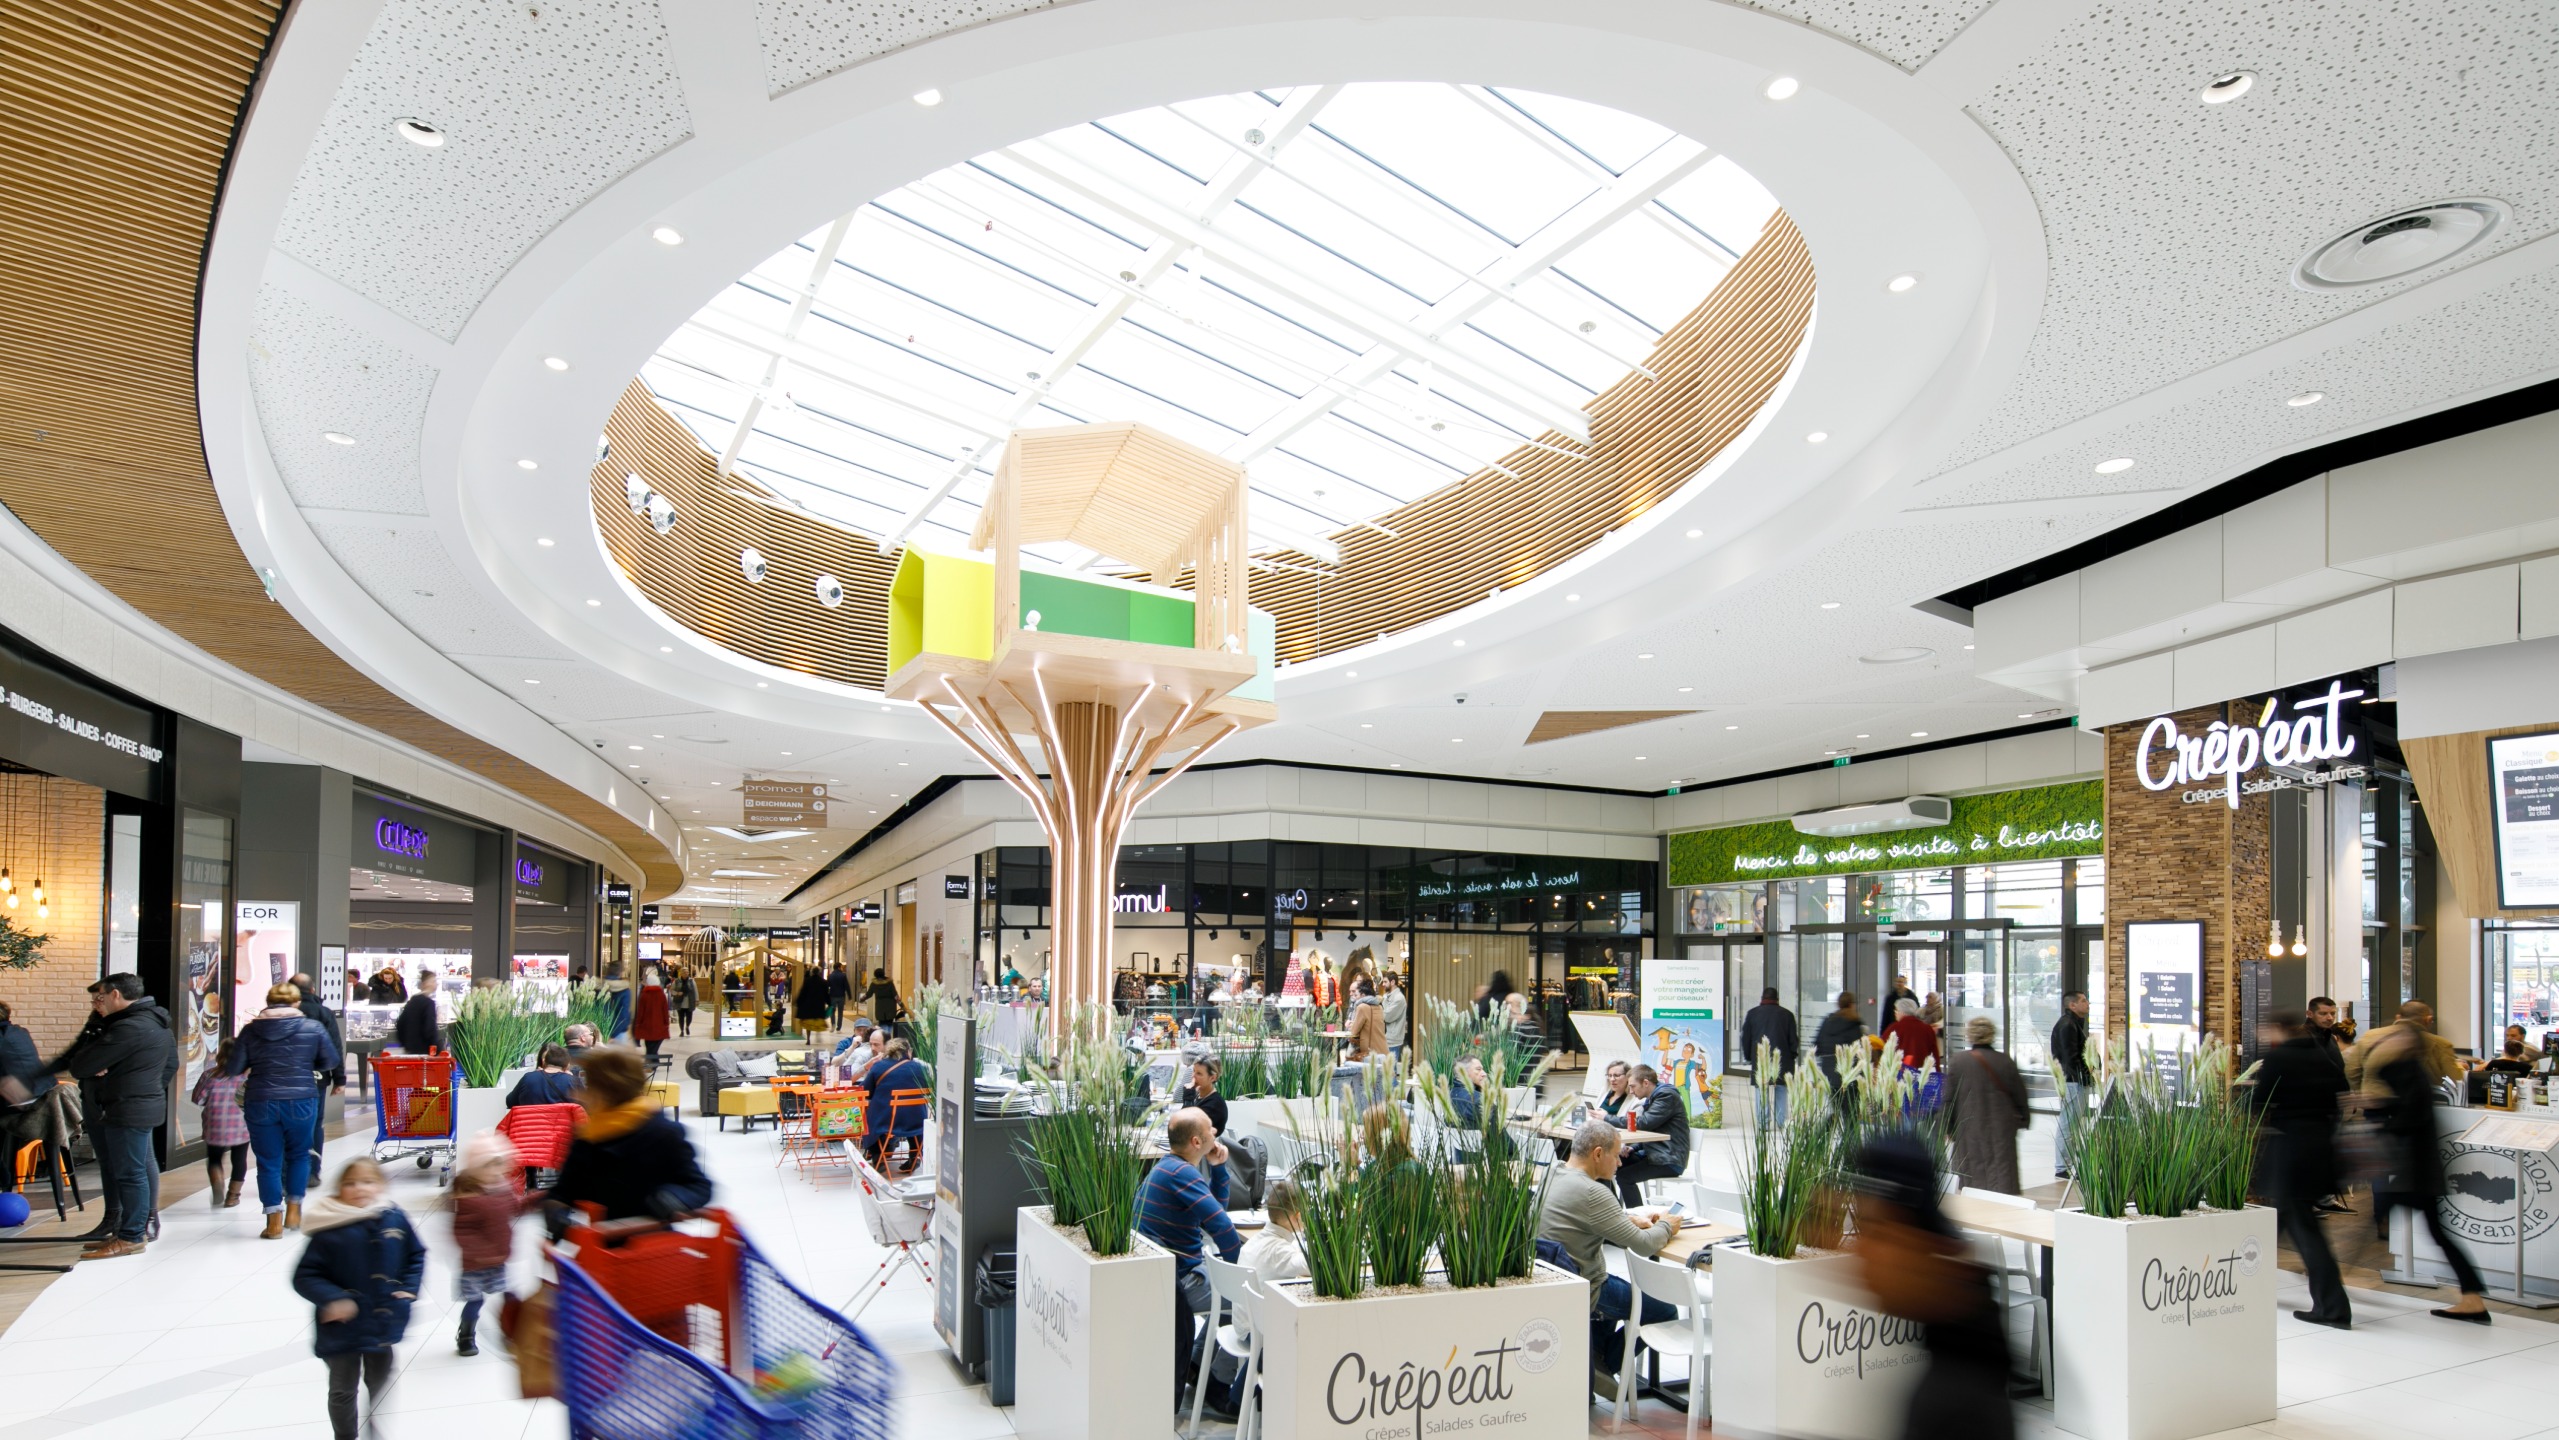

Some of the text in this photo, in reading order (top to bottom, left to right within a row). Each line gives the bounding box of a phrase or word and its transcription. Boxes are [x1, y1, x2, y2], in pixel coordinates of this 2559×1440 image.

[10, 691, 53, 724] BURGERS
[59, 713, 100, 742] SALADES
[105, 732, 138, 756] COFFEE
[139, 744, 163, 763] SHOP
[2136, 680, 2364, 809] Crêp'eat
[2505, 759, 2543, 768] Classique
[745, 785, 803, 793] promod
[2182, 788, 2228, 805] Crêpes
[2303, 766, 2366, 786] Gaufres
[1734, 855, 1788, 871] Merci
[1792, 844, 1818, 865] de
[1823, 842, 1881, 863] votre
[1970, 833, 1989, 850] à
[1998, 819, 2103, 848] bientôt
[1113, 884, 1171, 913] ormul.
[638, 926, 673, 934] ANGO
[2522, 1104, 2554, 1114] Epicerie
[1023, 1253, 1069, 1348] Crêp'eat
[2142, 1249, 2242, 1327] Crêp'eat
[2161, 1302, 2245, 1324] Crêpes Salades Gaufres
[1824, 1352, 1933, 1379] Crêpes Salades Gaufre
[1326, 1337, 1522, 1440] Crêp'eat
[1365, 1410, 1528, 1440] Crêpes Salades Gaufres
